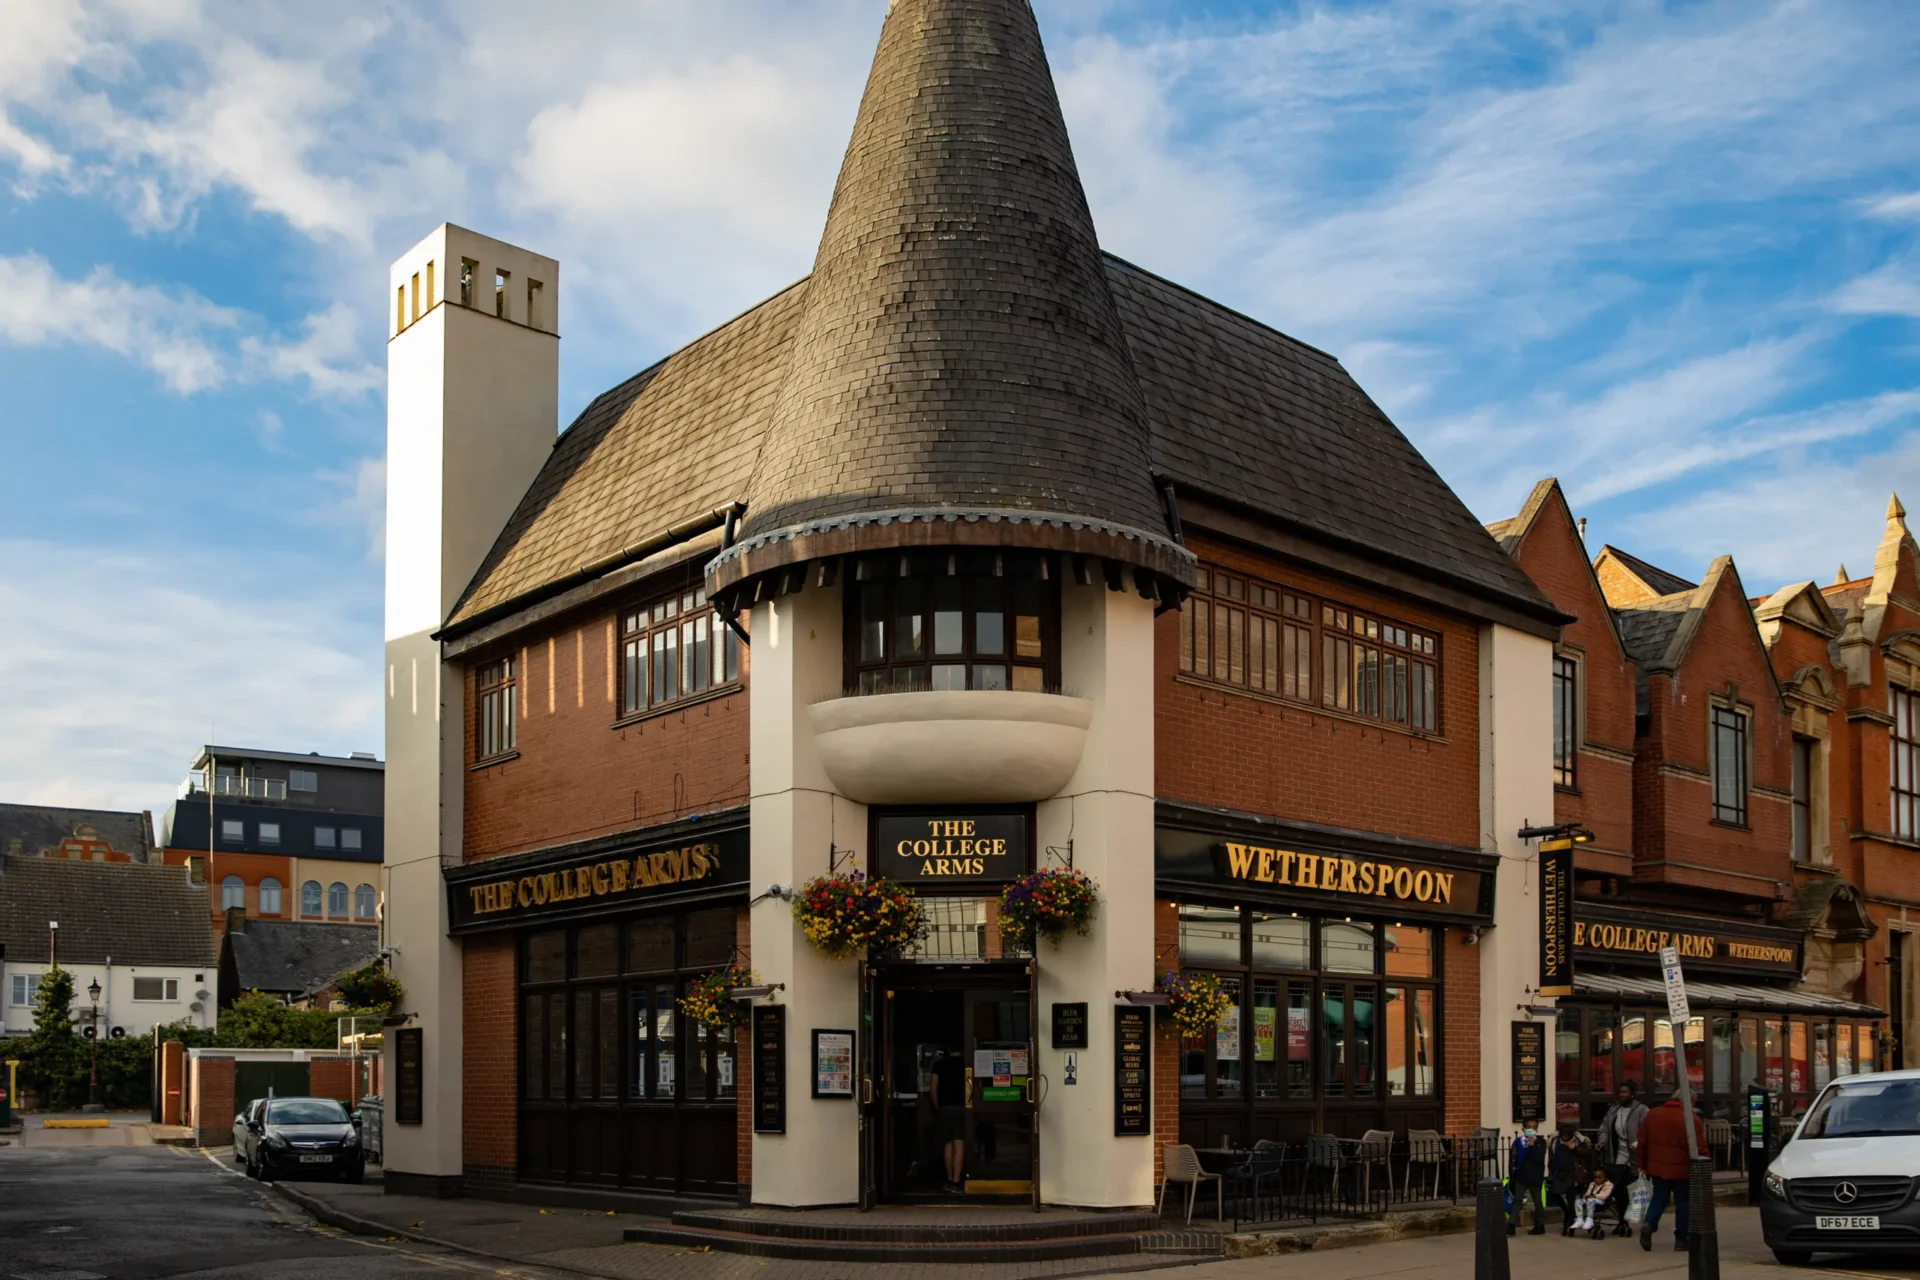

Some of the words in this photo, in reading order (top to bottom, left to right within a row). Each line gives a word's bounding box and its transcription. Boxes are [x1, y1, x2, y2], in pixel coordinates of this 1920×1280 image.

[928, 820, 976, 837] THE
[897, 838, 1007, 857] COLLEGE
[470, 882, 514, 915] THE
[517, 859, 628, 908] COLLEGE
[632, 843, 713, 890] ARMS
[920, 858, 984, 876] ARMS
[1225, 842, 1454, 904] WETHERSPOON
[1545, 858, 1557, 977] WETHERSPOON
[1558, 891, 1566, 936] COLLEGE
[1558, 936, 1566, 965] ARMS
[1671, 932, 1715, 958] ARMS
[1728, 942, 1793, 963] WETHERSPOON
[1820, 1217, 1848, 1228] DF67
[1851, 1217, 1874, 1228] ECE
